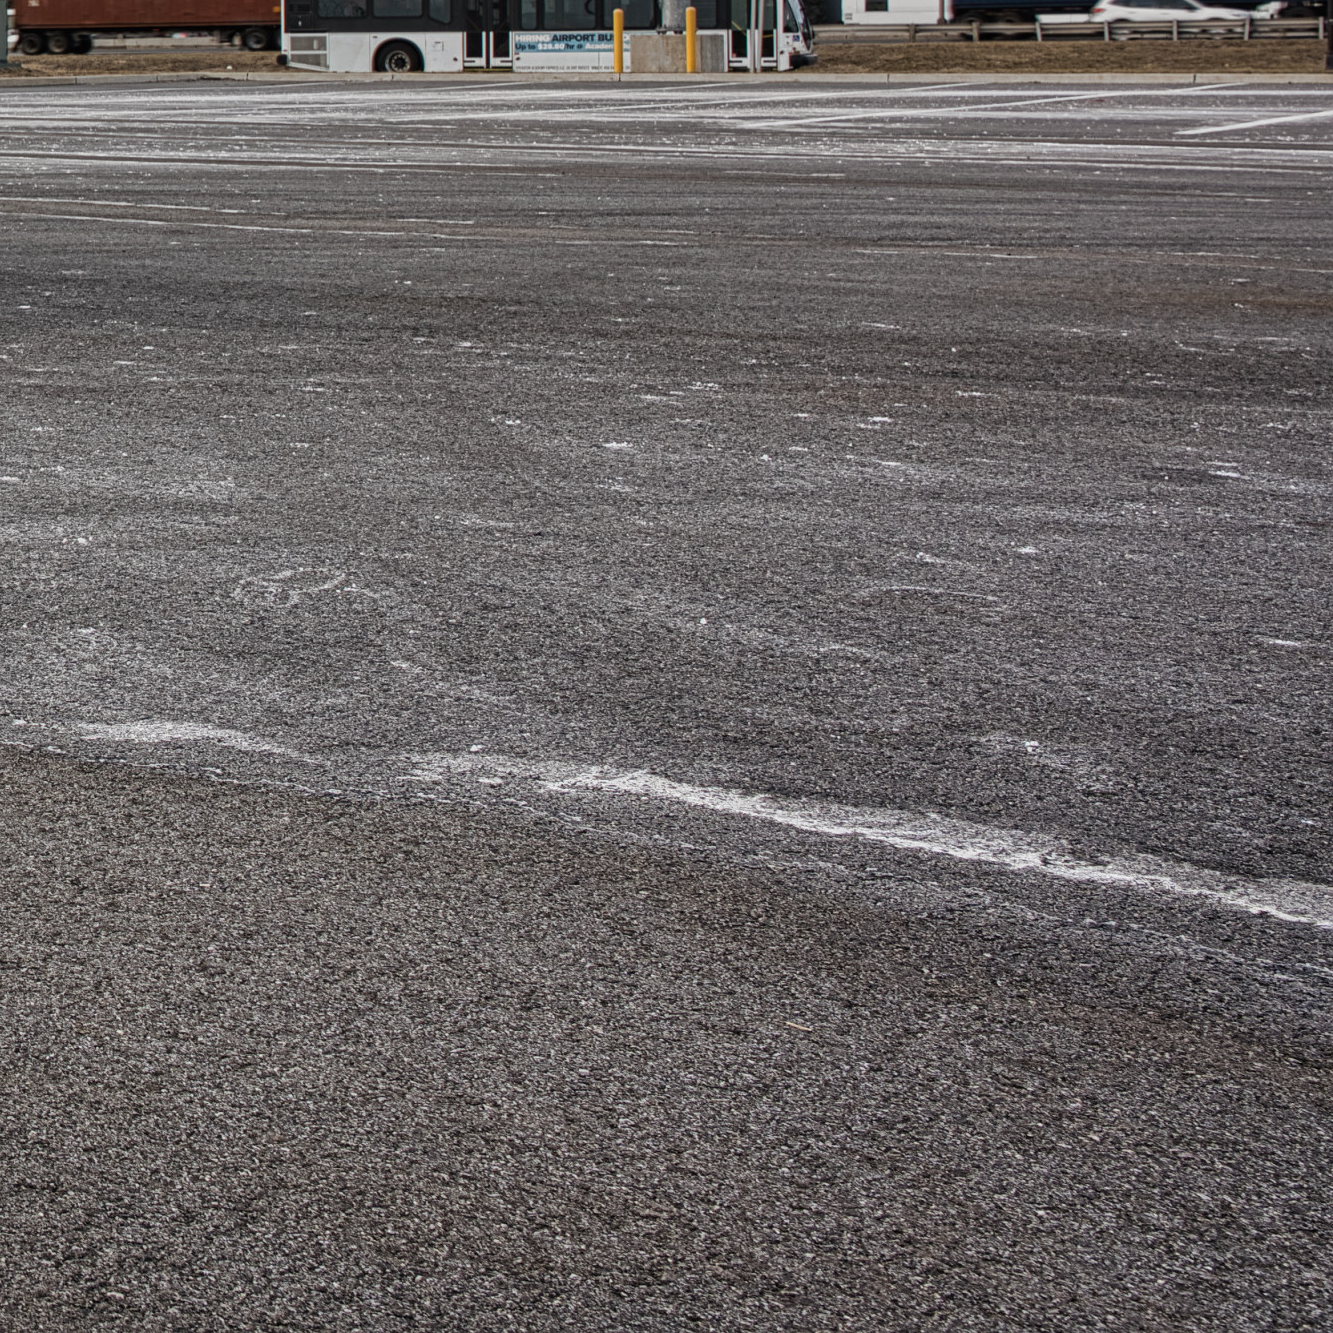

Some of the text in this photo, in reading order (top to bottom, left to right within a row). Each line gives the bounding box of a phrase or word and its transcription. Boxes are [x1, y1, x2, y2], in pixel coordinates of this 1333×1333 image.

[515, 34, 550, 43] HIRING
[552, 33, 595, 42] AIRPORT
[598, 33, 615, 42] BU
